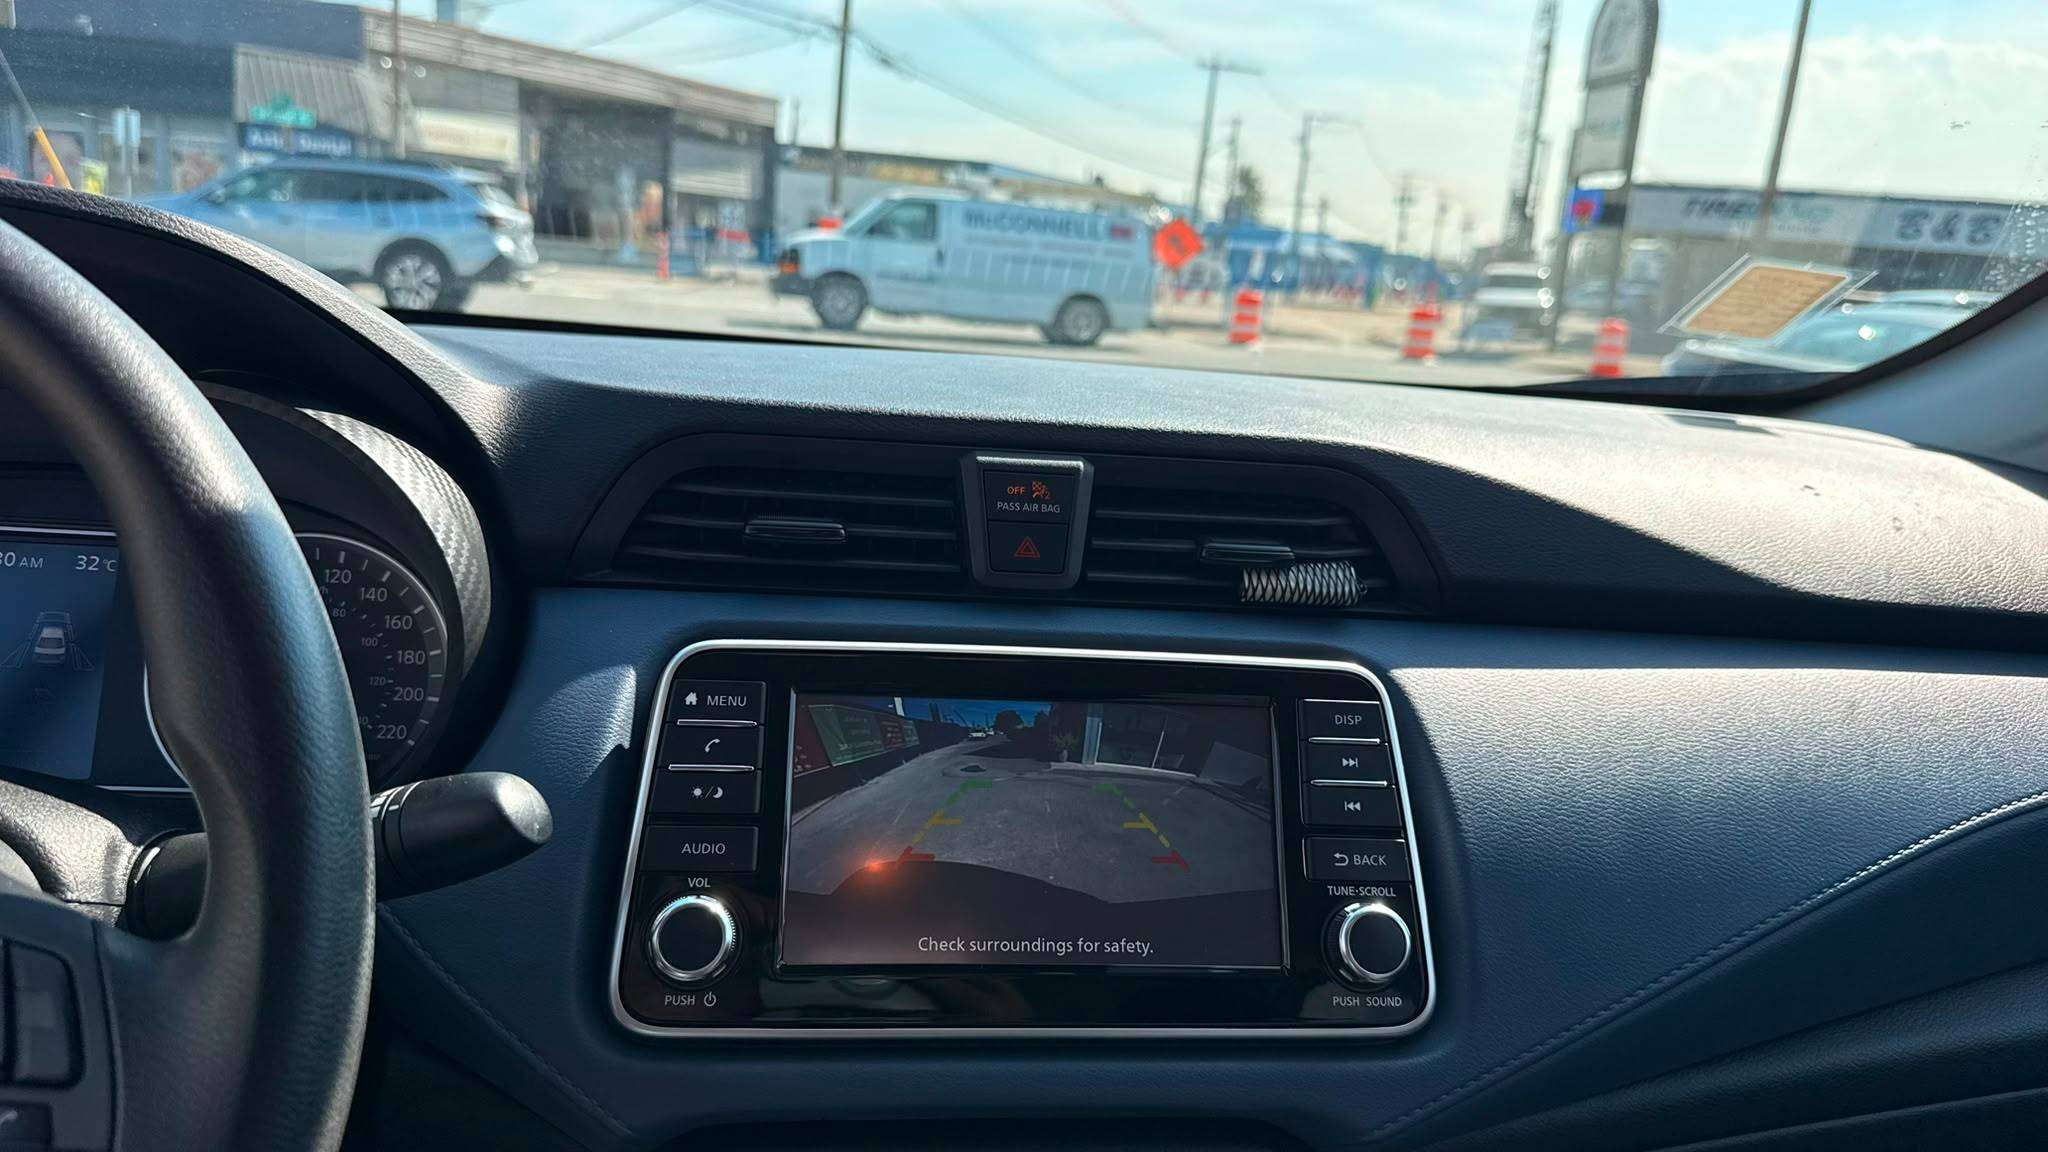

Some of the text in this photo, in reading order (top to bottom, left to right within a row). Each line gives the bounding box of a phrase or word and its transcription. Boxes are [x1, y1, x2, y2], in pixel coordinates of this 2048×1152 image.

[1007, 486, 1026, 495] OFF
[997, 501, 1060, 513] PASS AIR BAG
[19, 556, 44, 568] AM
[325, 569, 352, 584] 120
[360, 587, 388, 602] 140
[332, 608, 346, 617] 80
[385, 615, 413, 630] 160
[361, 637, 378, 647] 100
[398, 650, 426, 665] 180
[370, 676, 386, 686] 120
[393, 685, 424, 701] 200
[706, 695, 747, 707] MENU
[1334, 714, 1362, 726] DISP
[376, 724, 407, 740] 220
[681, 843, 726, 855] AUDIO
[1353, 854, 1387, 866] BACK
[687, 877, 711, 888] VOL
[918, 937, 1154, 957] Check surroundings for safety.
[664, 994, 695, 1006] PUSH
[1332, 996, 1402, 1008] PUSH SOUND
